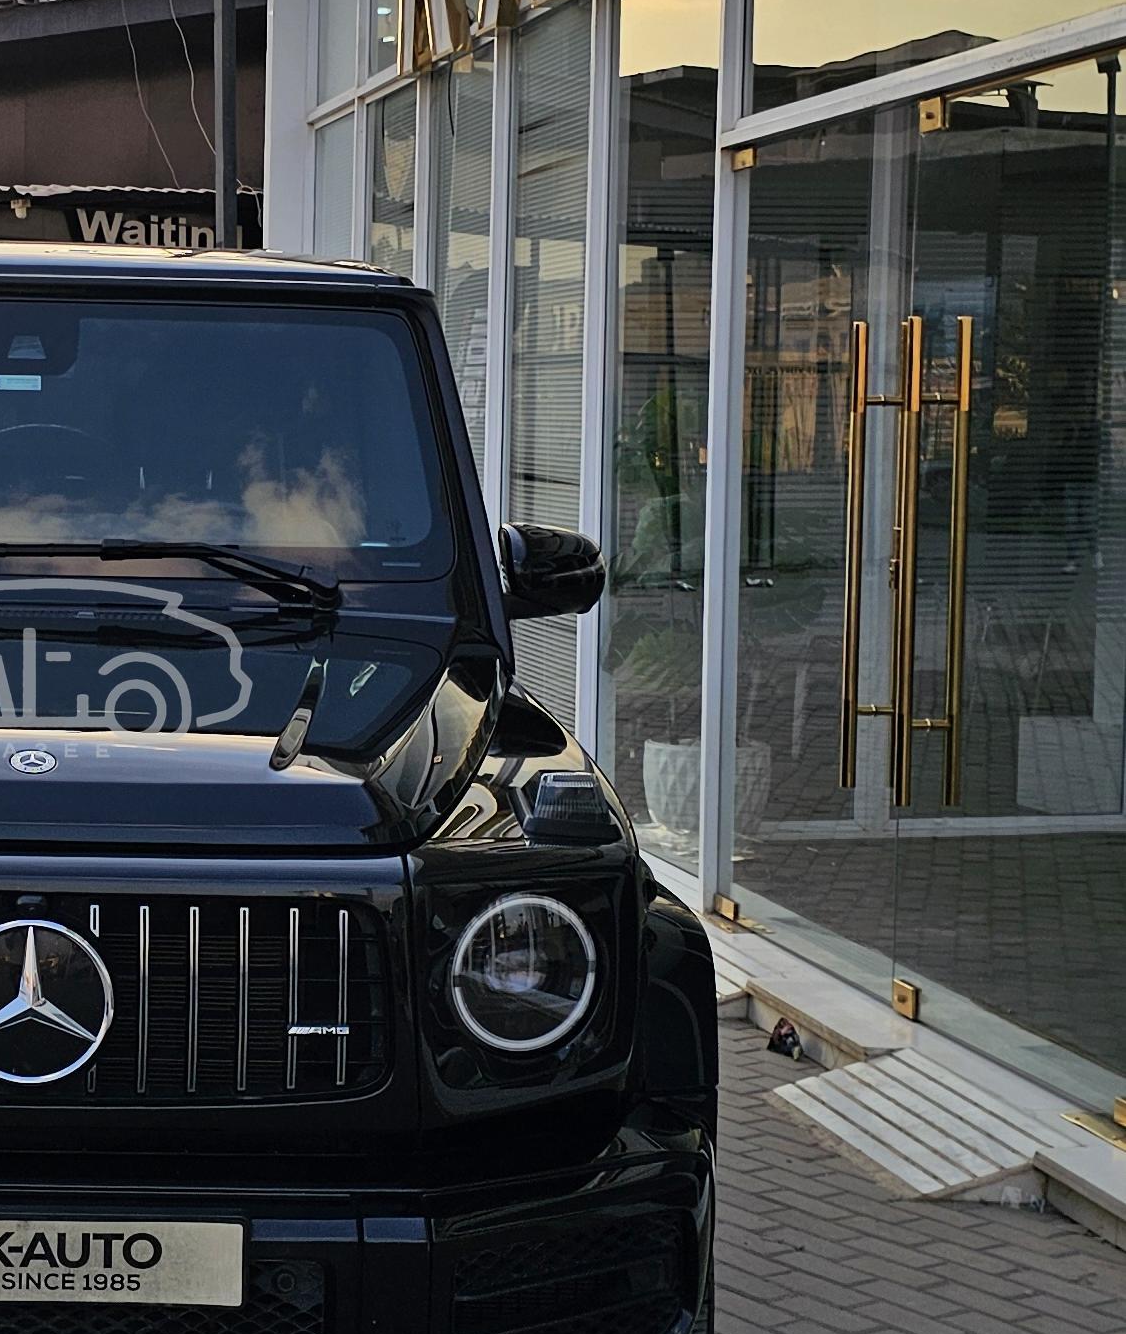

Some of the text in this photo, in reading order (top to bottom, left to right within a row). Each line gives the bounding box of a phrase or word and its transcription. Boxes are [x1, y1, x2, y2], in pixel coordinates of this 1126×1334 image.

[77, 208, 242, 250] Waitin
[1, 1272, 141, 1292] SINCE 1985
